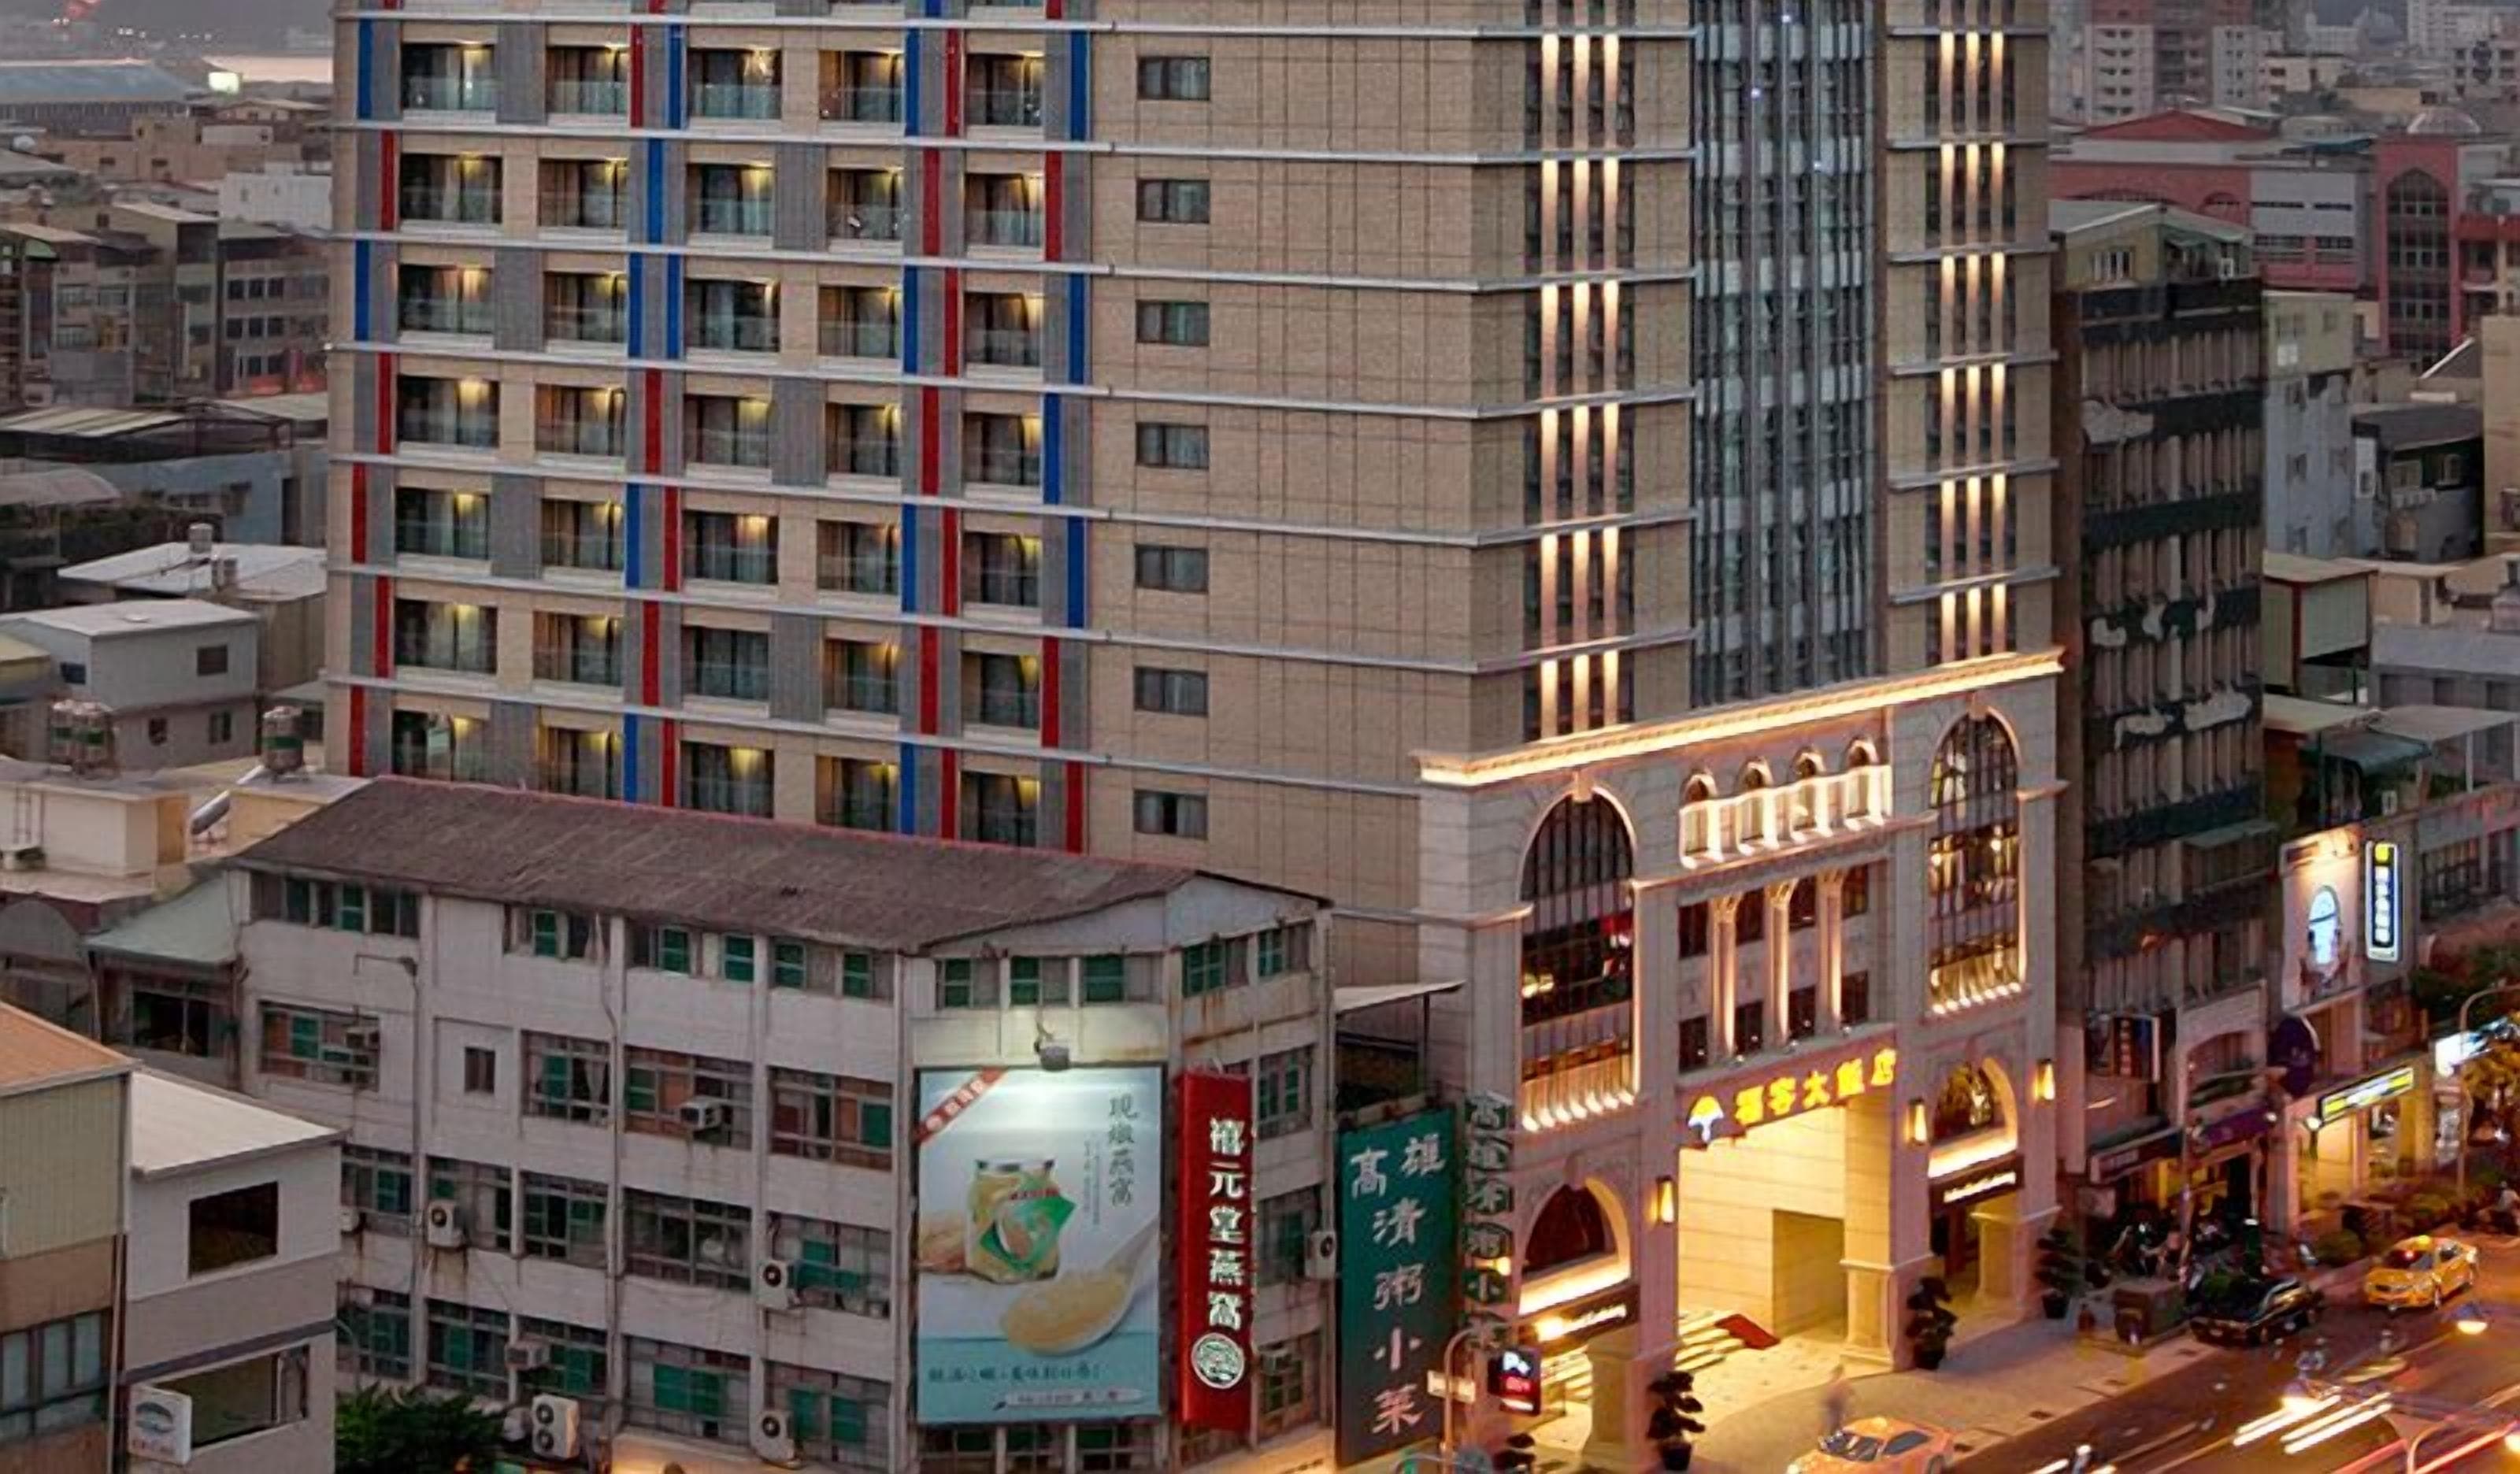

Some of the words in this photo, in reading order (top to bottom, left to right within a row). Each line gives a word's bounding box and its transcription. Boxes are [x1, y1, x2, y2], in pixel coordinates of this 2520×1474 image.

[1209, 1117, 1246, 1331] 禧元堂燕窩
